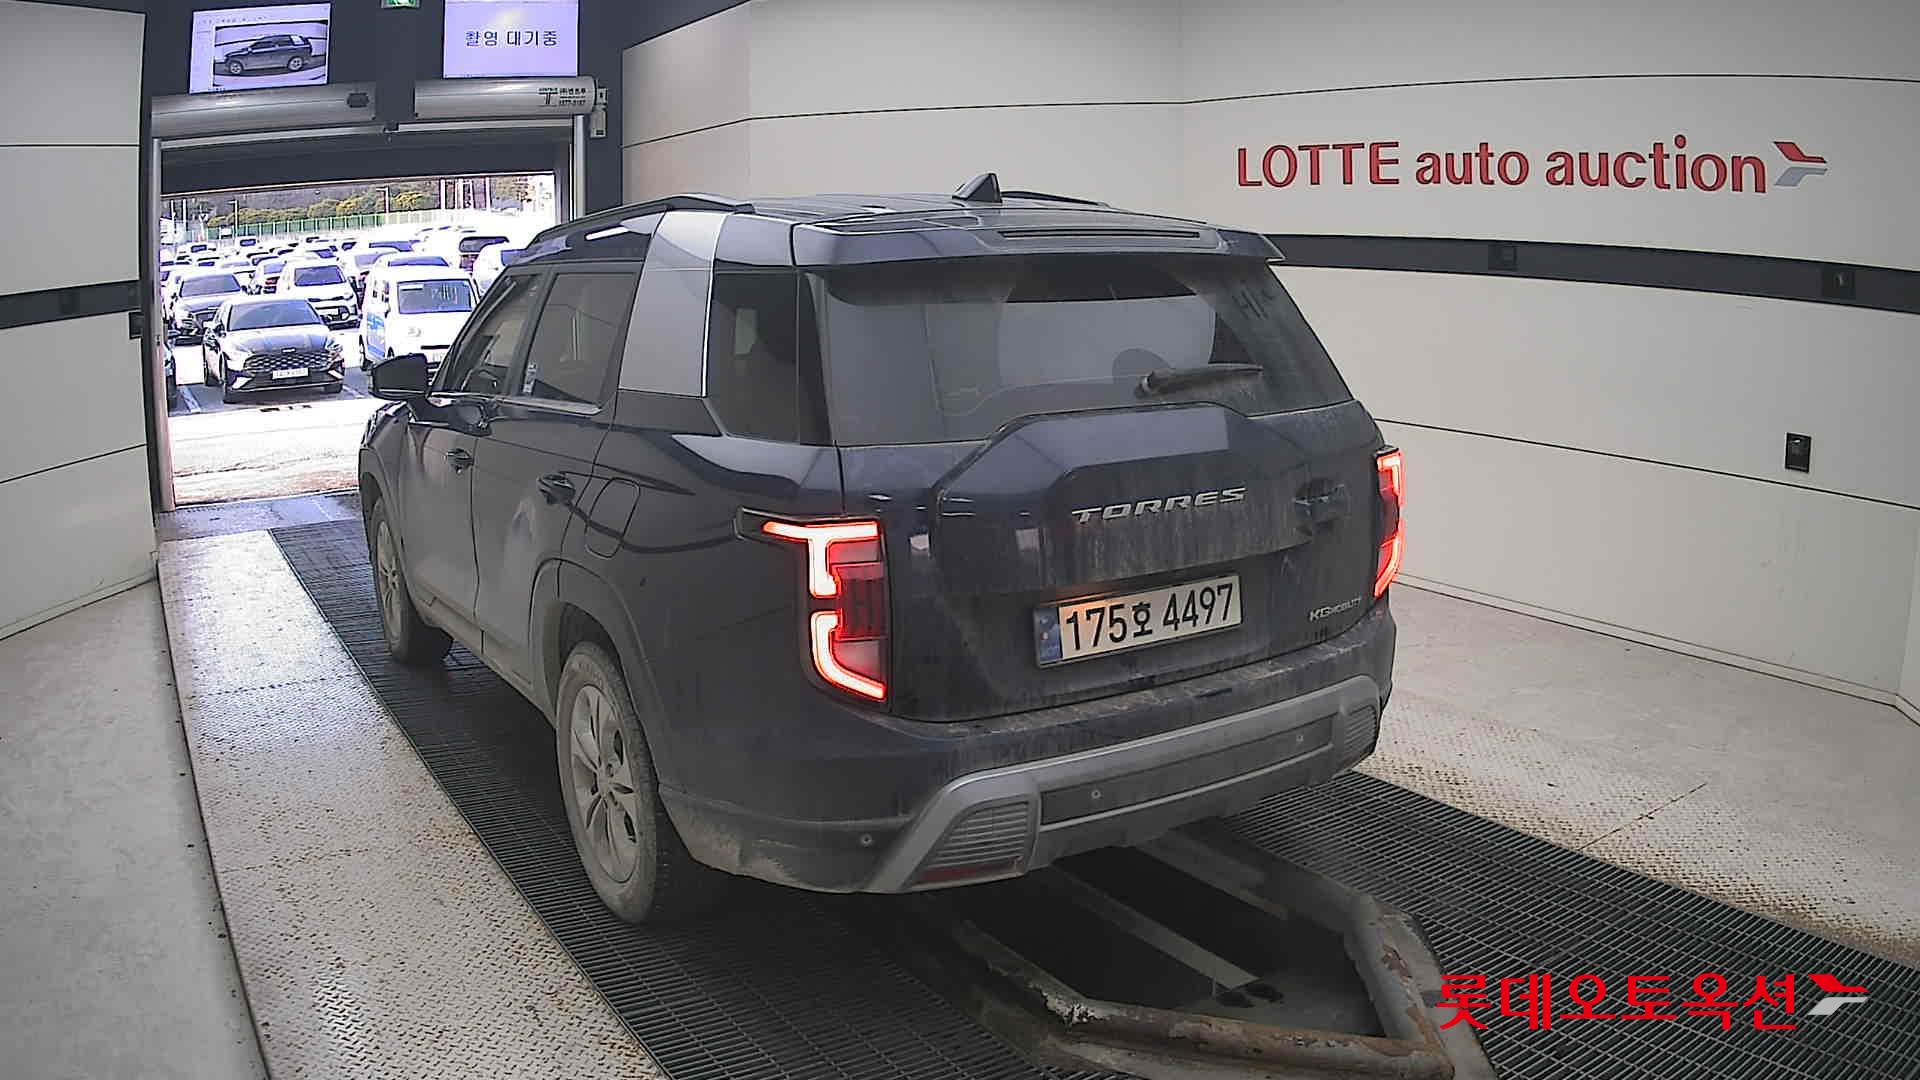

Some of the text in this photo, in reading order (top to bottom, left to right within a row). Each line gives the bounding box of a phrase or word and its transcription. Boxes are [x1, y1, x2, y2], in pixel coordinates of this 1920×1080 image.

[465, 30, 558, 47] 촬영 대기중
[1237, 134, 1767, 194] LOTTE auto auction
[1071, 486, 1247, 525] TORRES
[1065, 582, 1234, 651] 175호 4497
